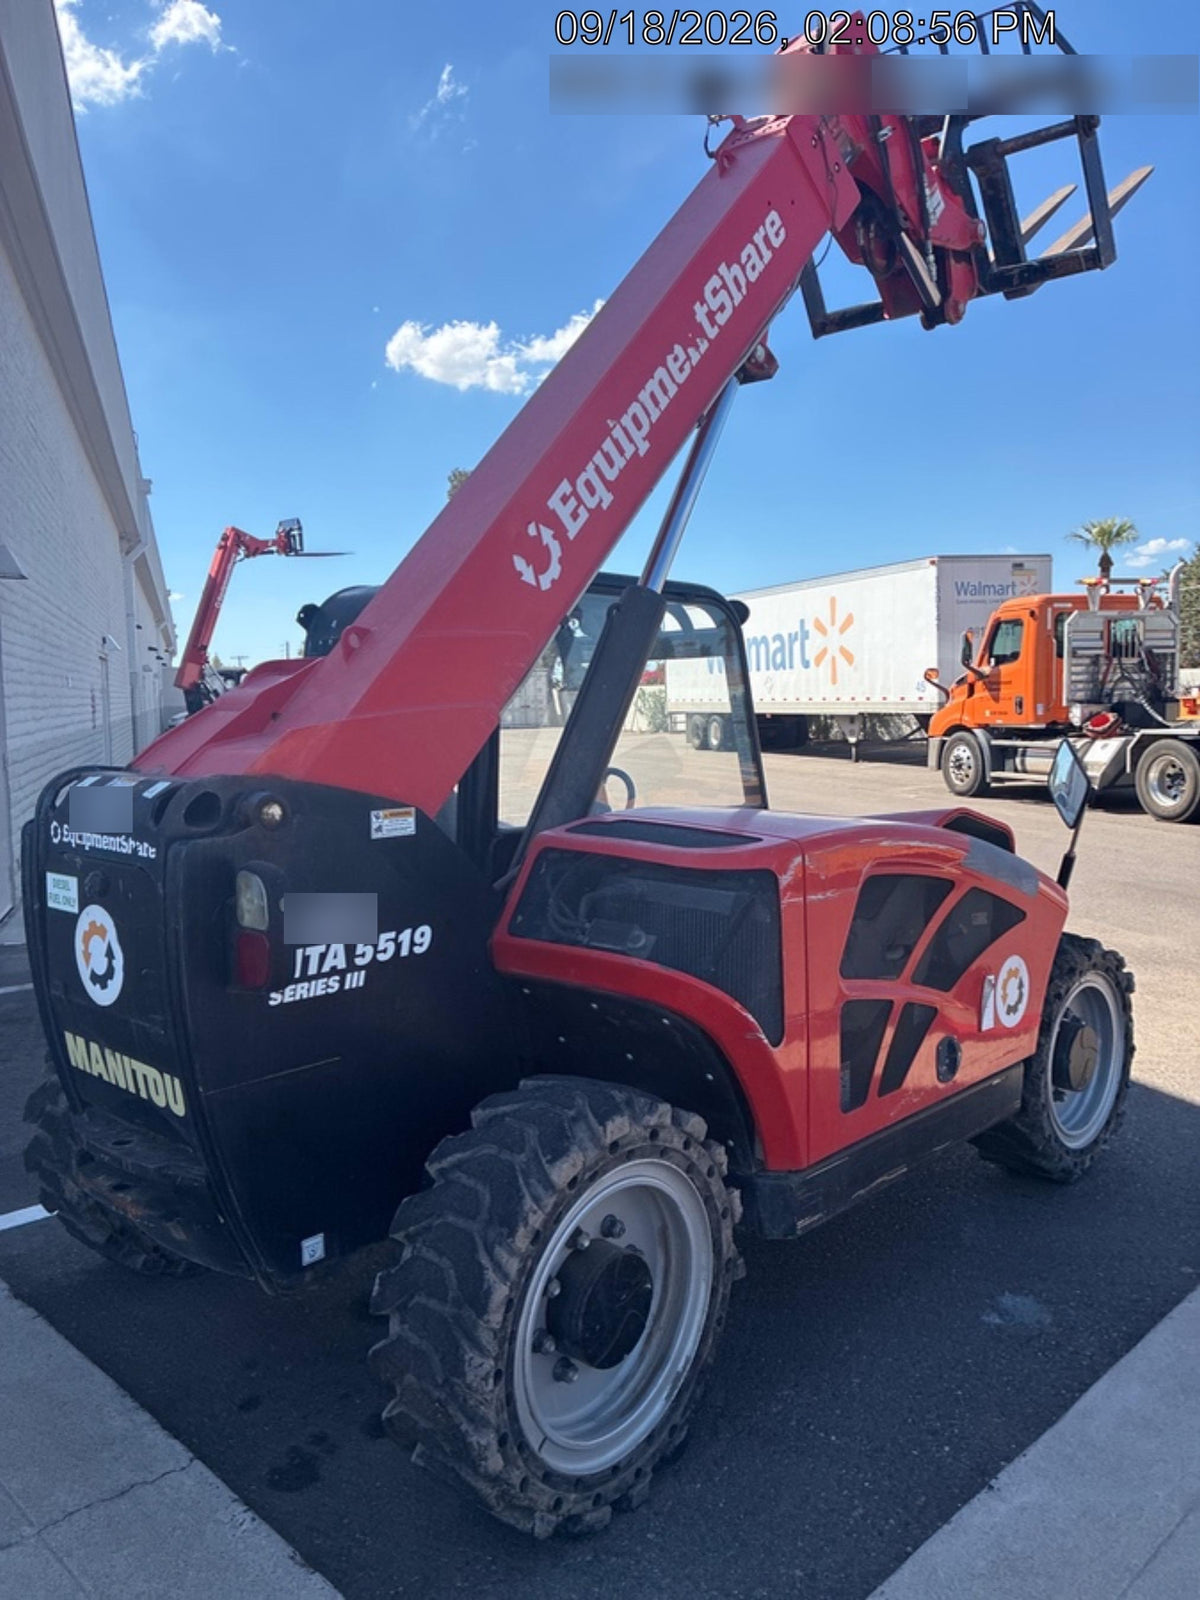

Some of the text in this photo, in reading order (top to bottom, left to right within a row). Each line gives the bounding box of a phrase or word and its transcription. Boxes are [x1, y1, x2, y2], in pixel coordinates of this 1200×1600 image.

[954, 580, 1017, 597] Walmart
[354, 924, 433, 967] 5519
[268, 970, 367, 1007] SERIES III
[64, 1030, 186, 1117] MANITOU
